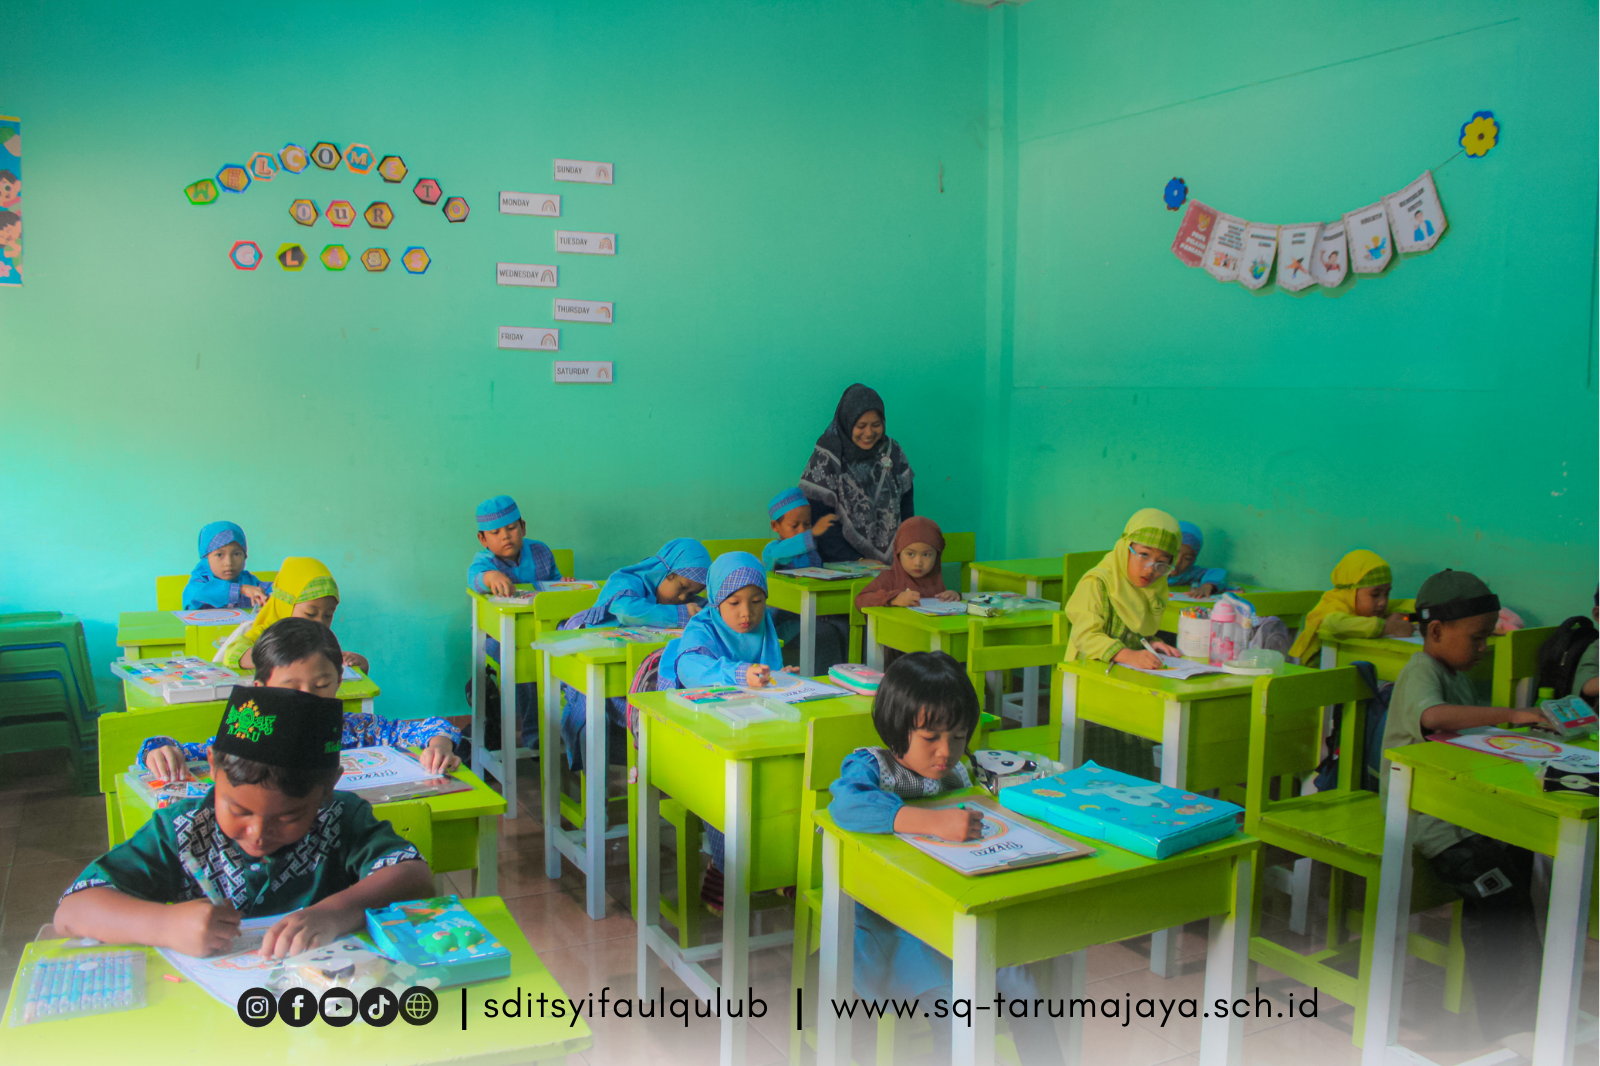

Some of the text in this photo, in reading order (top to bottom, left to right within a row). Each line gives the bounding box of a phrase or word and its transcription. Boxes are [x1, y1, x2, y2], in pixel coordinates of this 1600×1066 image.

[556, 165, 583, 174] SUNDAY
[192, 146, 467, 220] WELCOME TO
[502, 198, 530, 207] MONDAY
[559, 237, 588, 246] TUESDAY
[235, 244, 423, 269] CLASS
[499, 269, 539, 279] WEDNESDAY
[557, 305, 591, 314] THURSDAY
[501, 333, 524, 341] FRIDAY
[557, 367, 590, 376] SATURDAY
